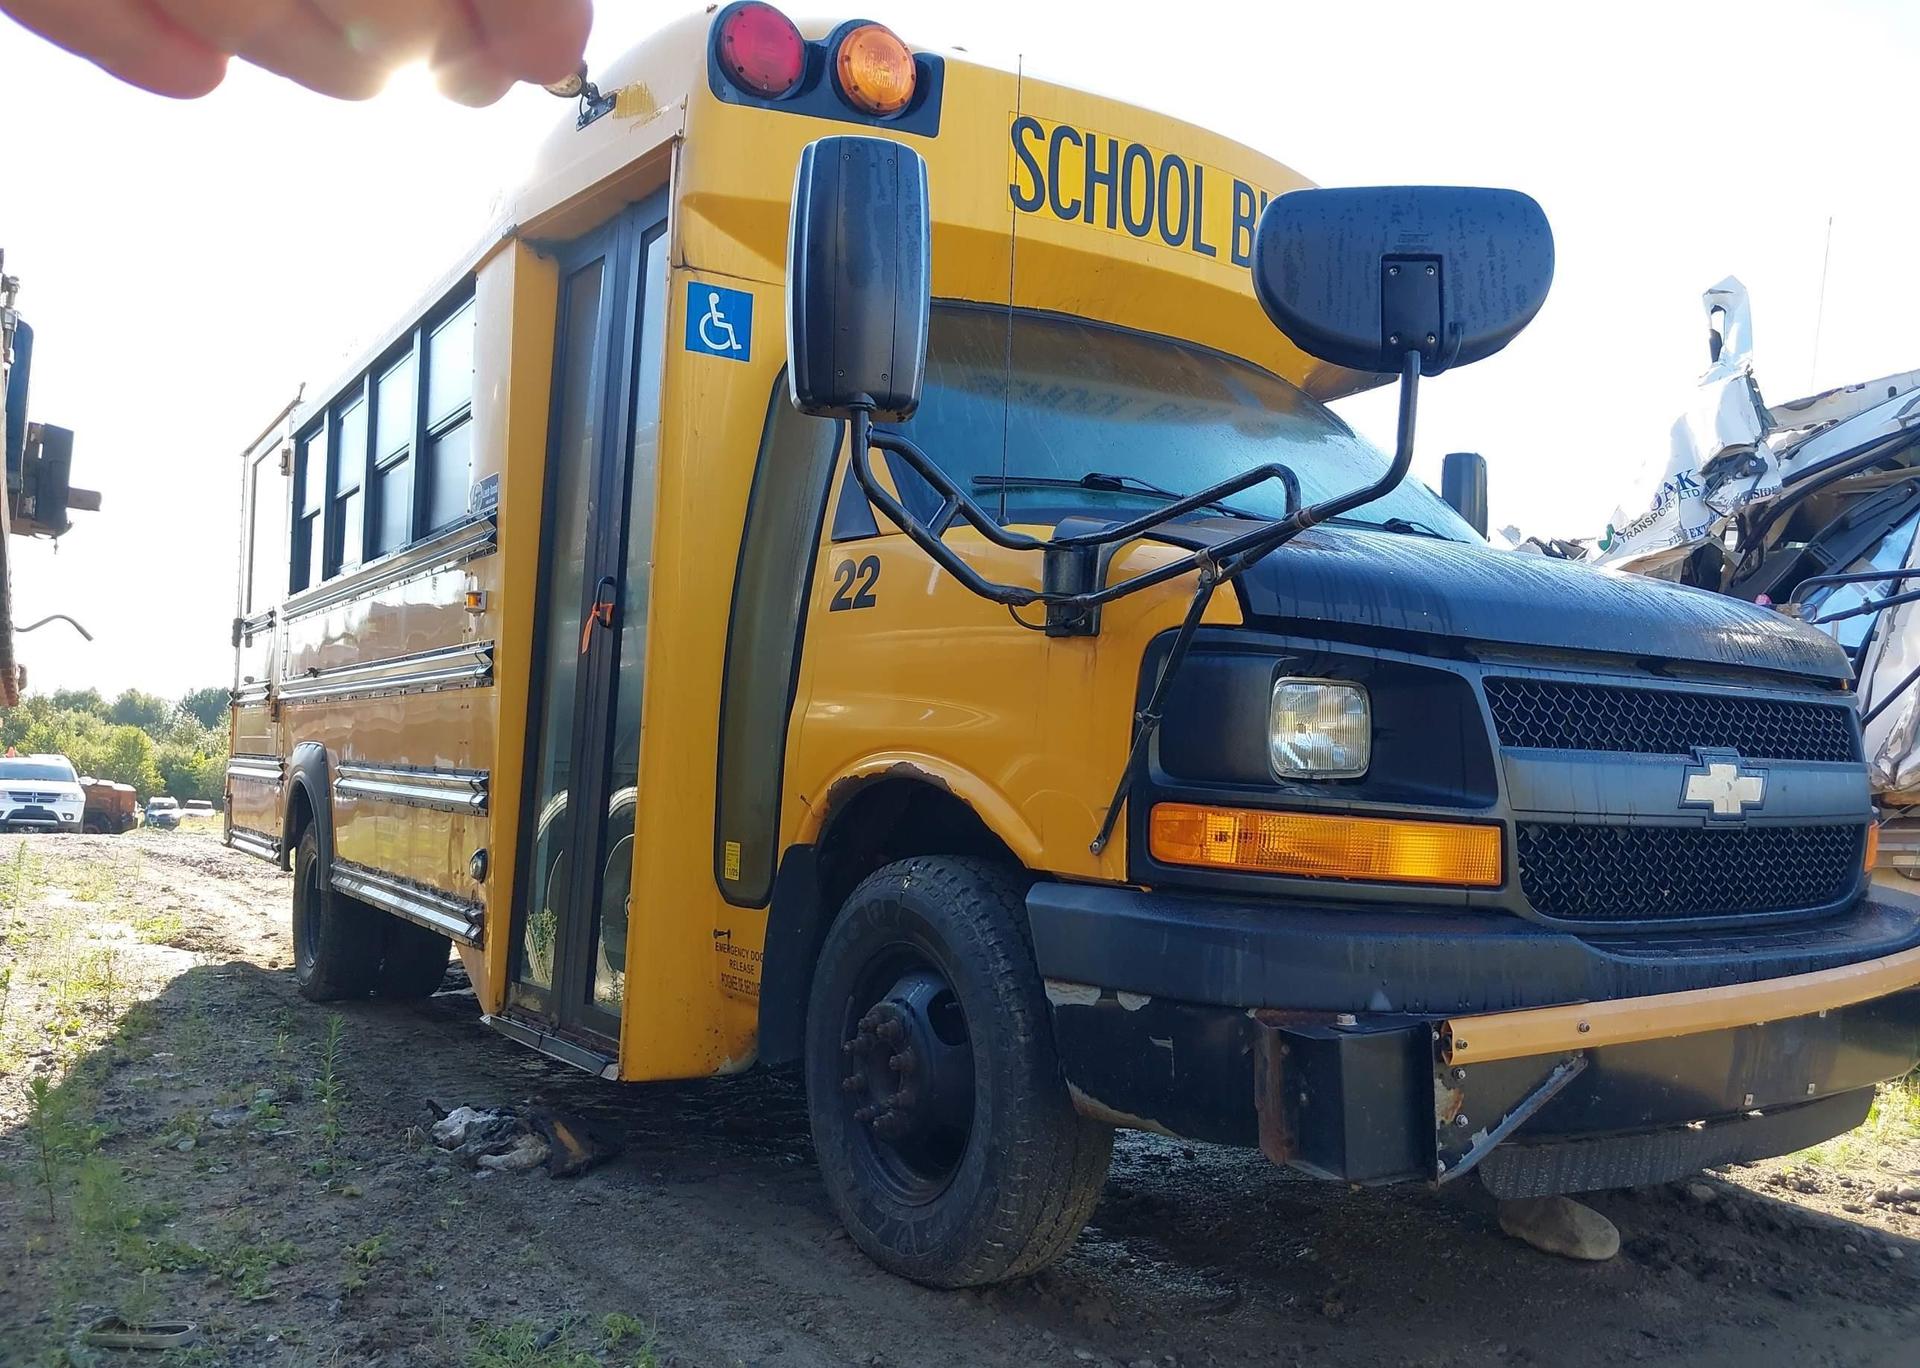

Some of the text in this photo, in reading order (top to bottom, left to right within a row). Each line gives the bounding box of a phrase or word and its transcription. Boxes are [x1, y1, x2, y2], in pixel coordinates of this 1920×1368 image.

[1009, 116, 1217, 258] SCHOOL
[1619, 498, 1676, 543] TRANSPORT
[1679, 488, 1700, 500] LTD
[829, 554, 881, 612] 22
[715, 941, 749, 959] EMERGENCY
[729, 958, 755, 975] RELEASE
